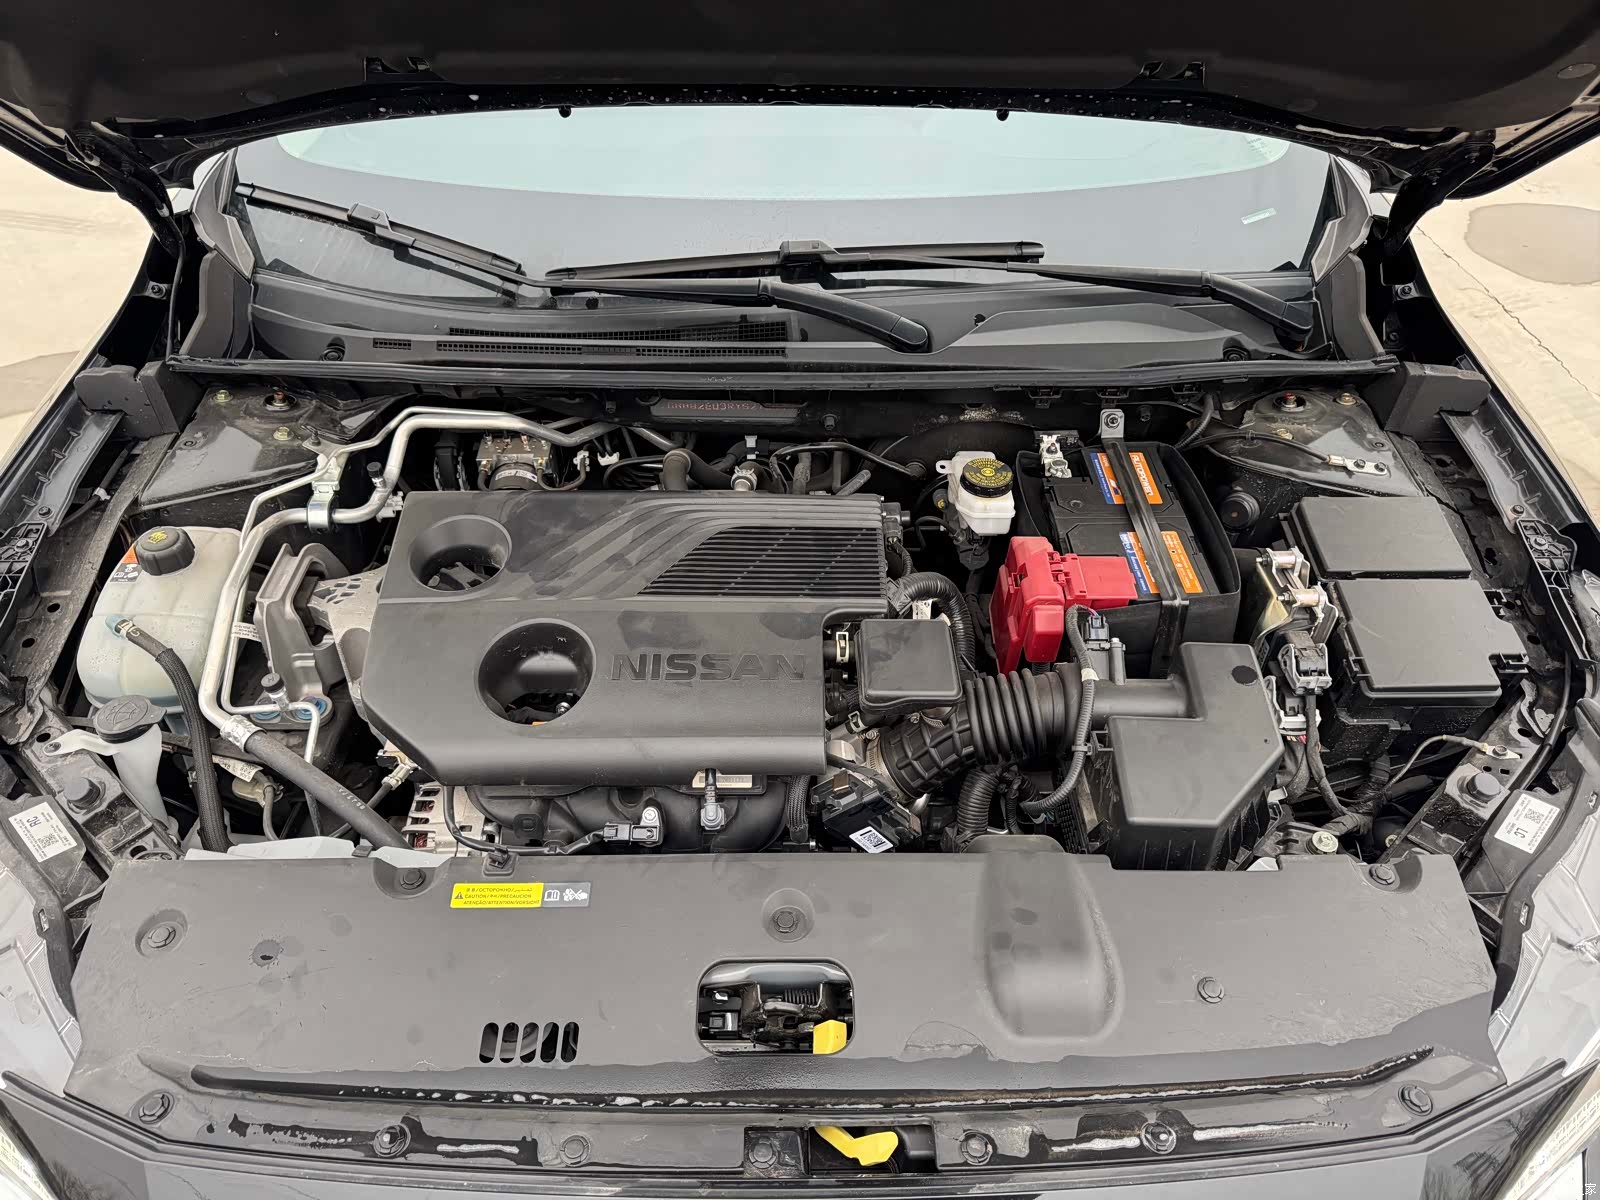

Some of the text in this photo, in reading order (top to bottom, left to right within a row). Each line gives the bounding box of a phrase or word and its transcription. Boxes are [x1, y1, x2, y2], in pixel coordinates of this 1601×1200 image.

[611, 653, 805, 681] NISSAN
[27, 816, 41, 828] RC
[1514, 827, 1528, 839] LC
